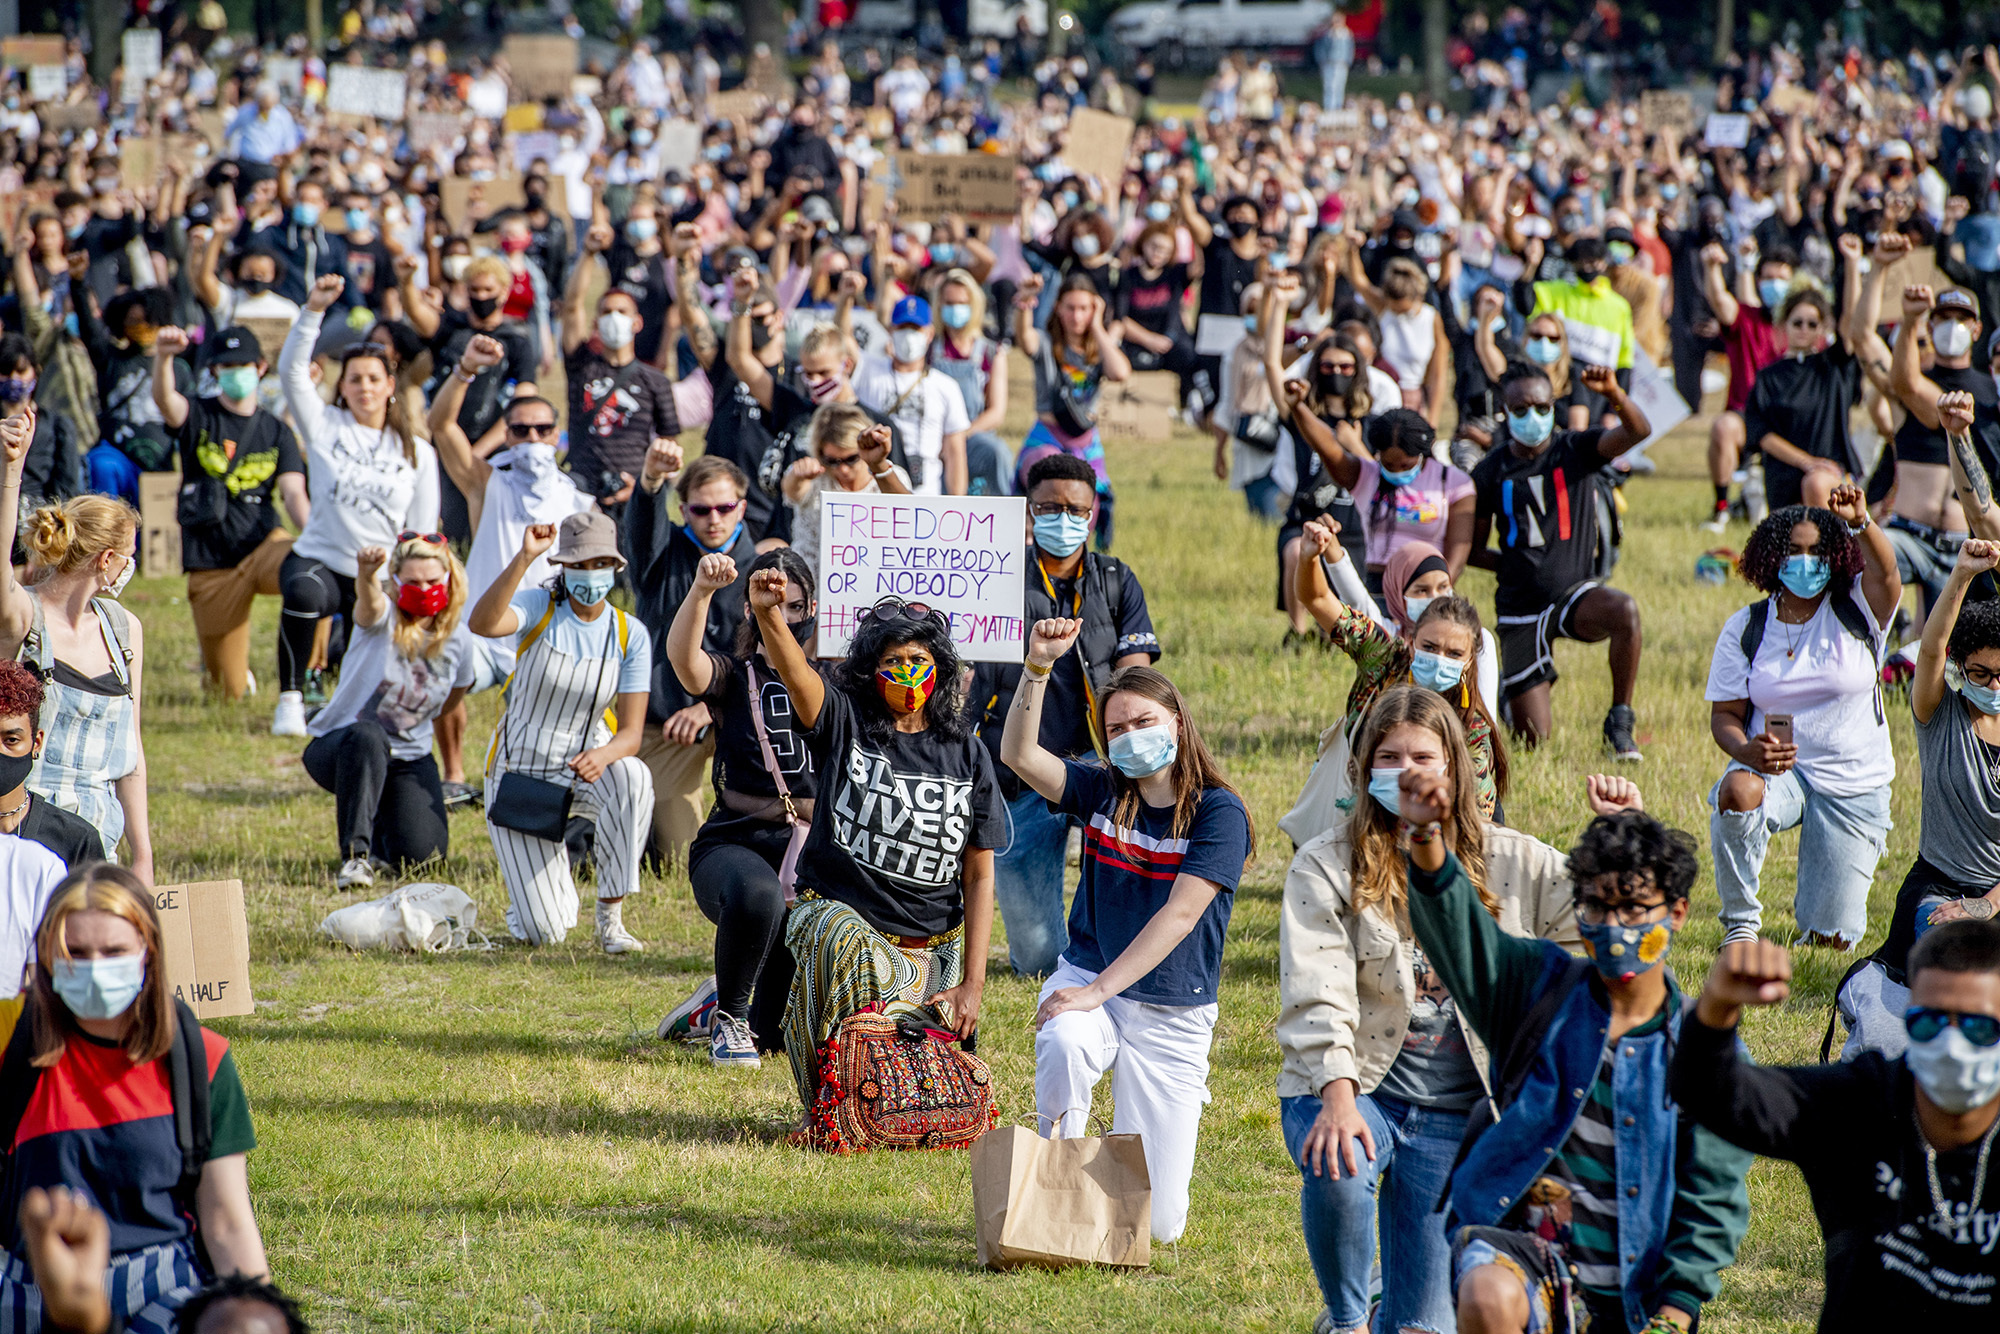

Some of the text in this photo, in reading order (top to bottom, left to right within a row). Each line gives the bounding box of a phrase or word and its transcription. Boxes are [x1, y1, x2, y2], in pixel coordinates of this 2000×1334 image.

[826, 502, 995, 543] FREEDOM
[831, 545, 1012, 575] FOR EVERYBODY
[827, 572, 989, 601] OR NOBODY.
[846, 749, 974, 817] BLACK
[835, 778, 965, 853] LIVES
[832, 812, 958, 883] MATTER
[175, 981, 230, 1003] A HALF
